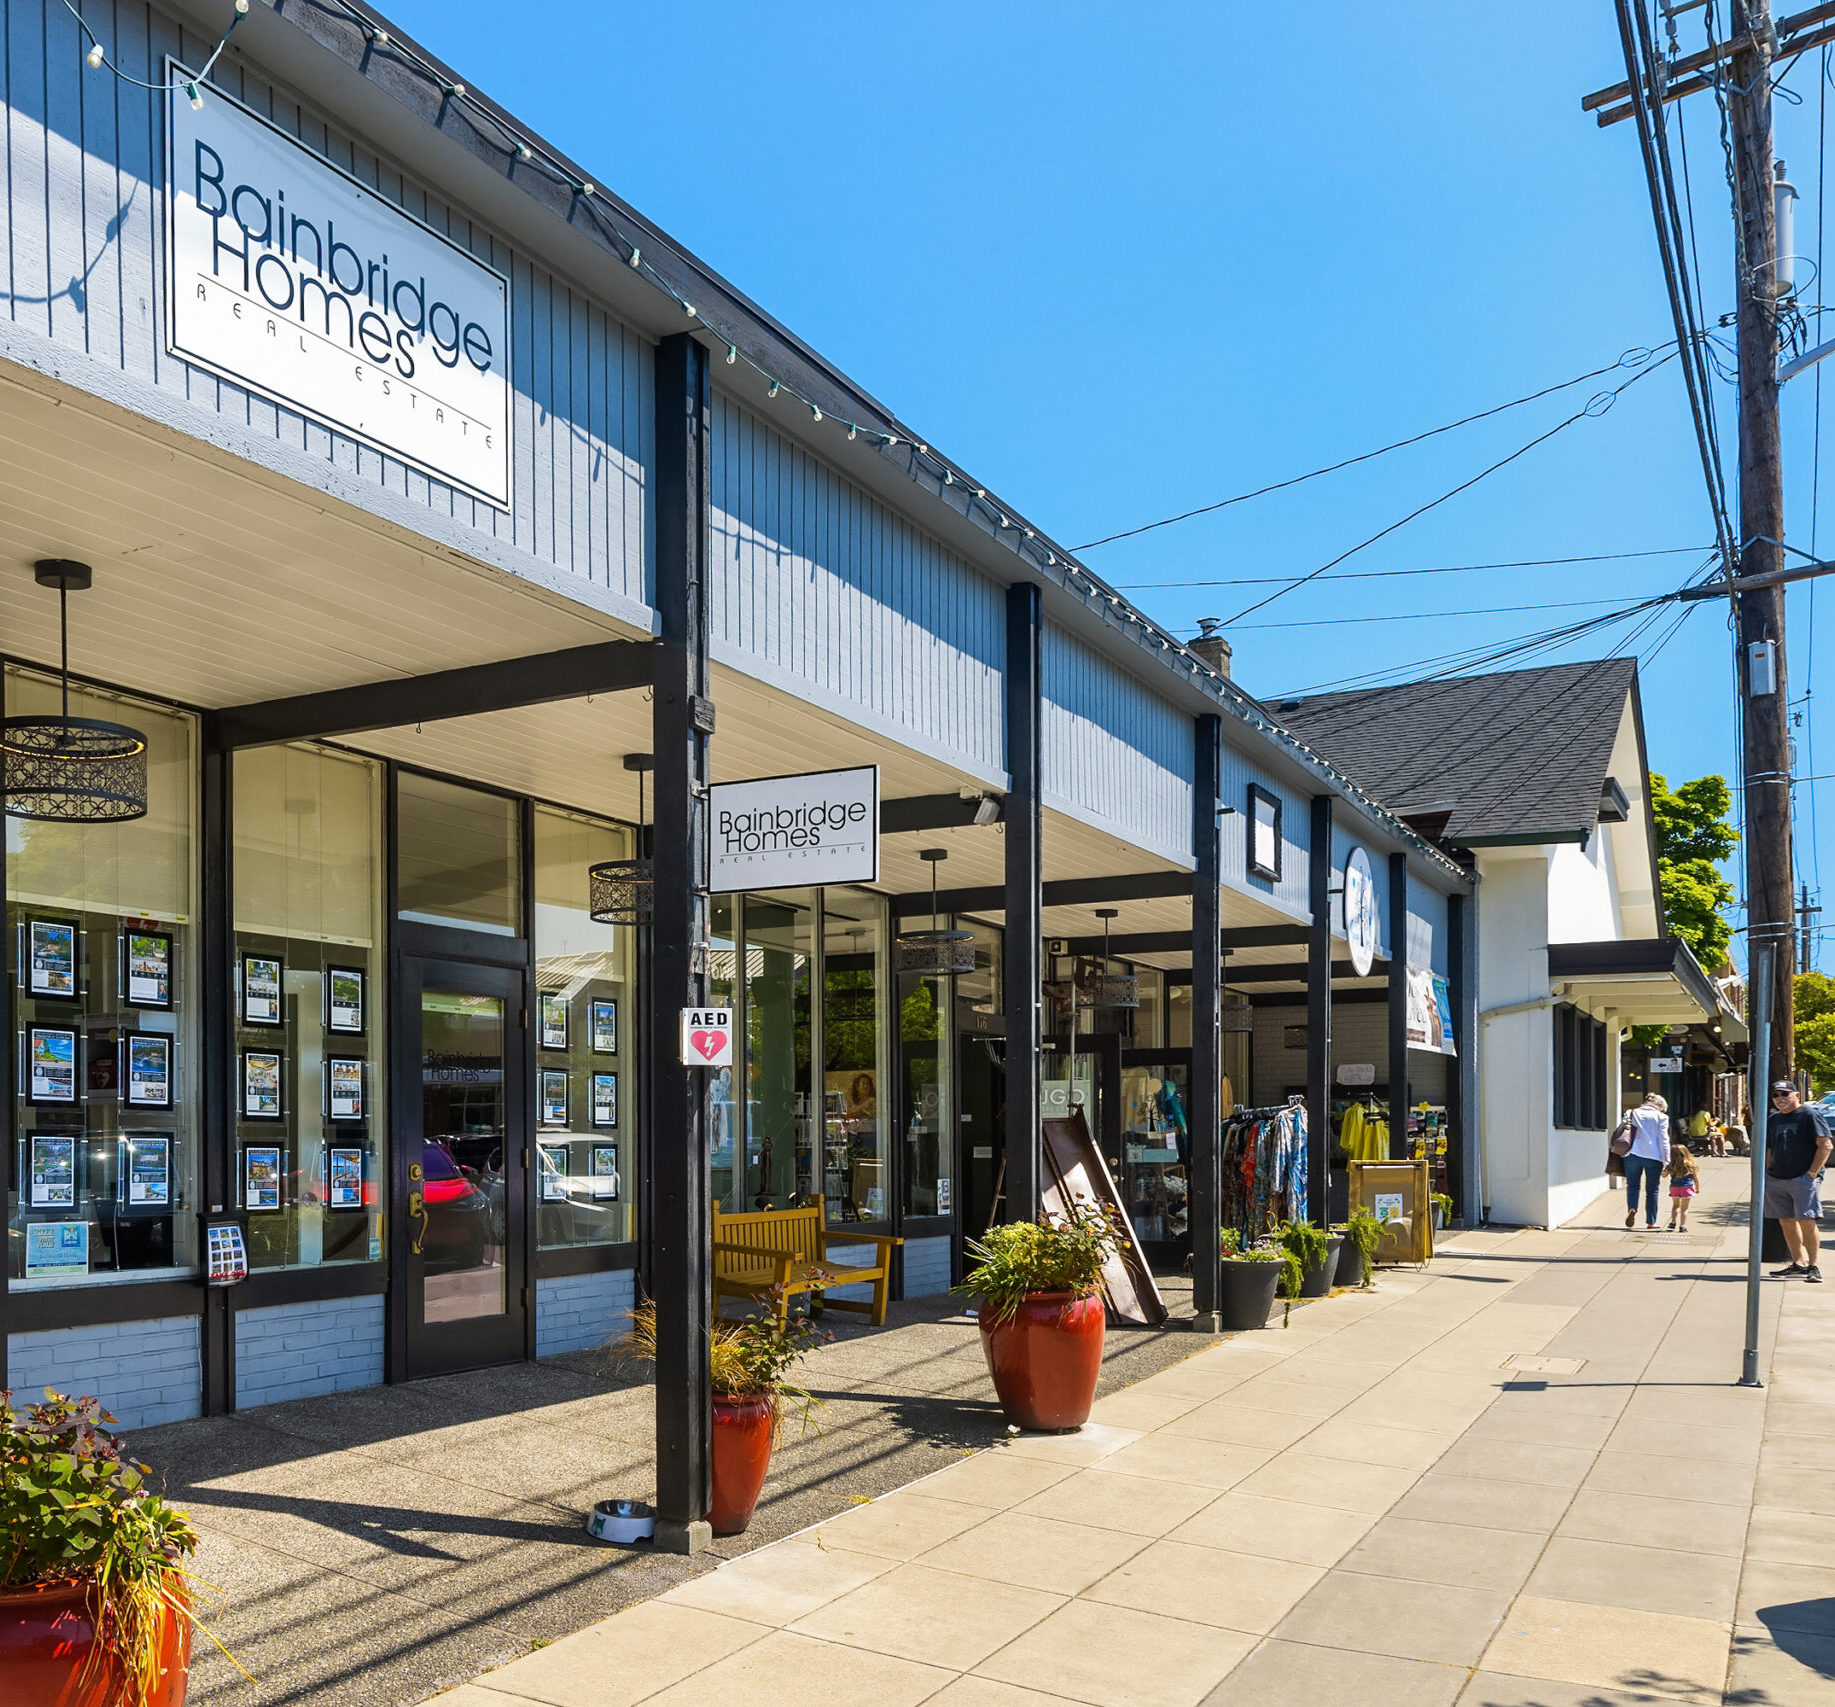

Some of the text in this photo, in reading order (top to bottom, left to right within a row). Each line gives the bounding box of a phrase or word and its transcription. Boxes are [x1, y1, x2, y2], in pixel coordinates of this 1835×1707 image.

[195, 138, 493, 371] Bainbridge
[212, 207, 415, 379] Homes
[196, 283, 493, 450] REAL ESTATE
[719, 800, 866, 834] Bainbridge
[719, 846, 866, 865] REAL ESTATE
[726, 826, 820, 853] Homes
[690, 1012, 728, 1026] AED
